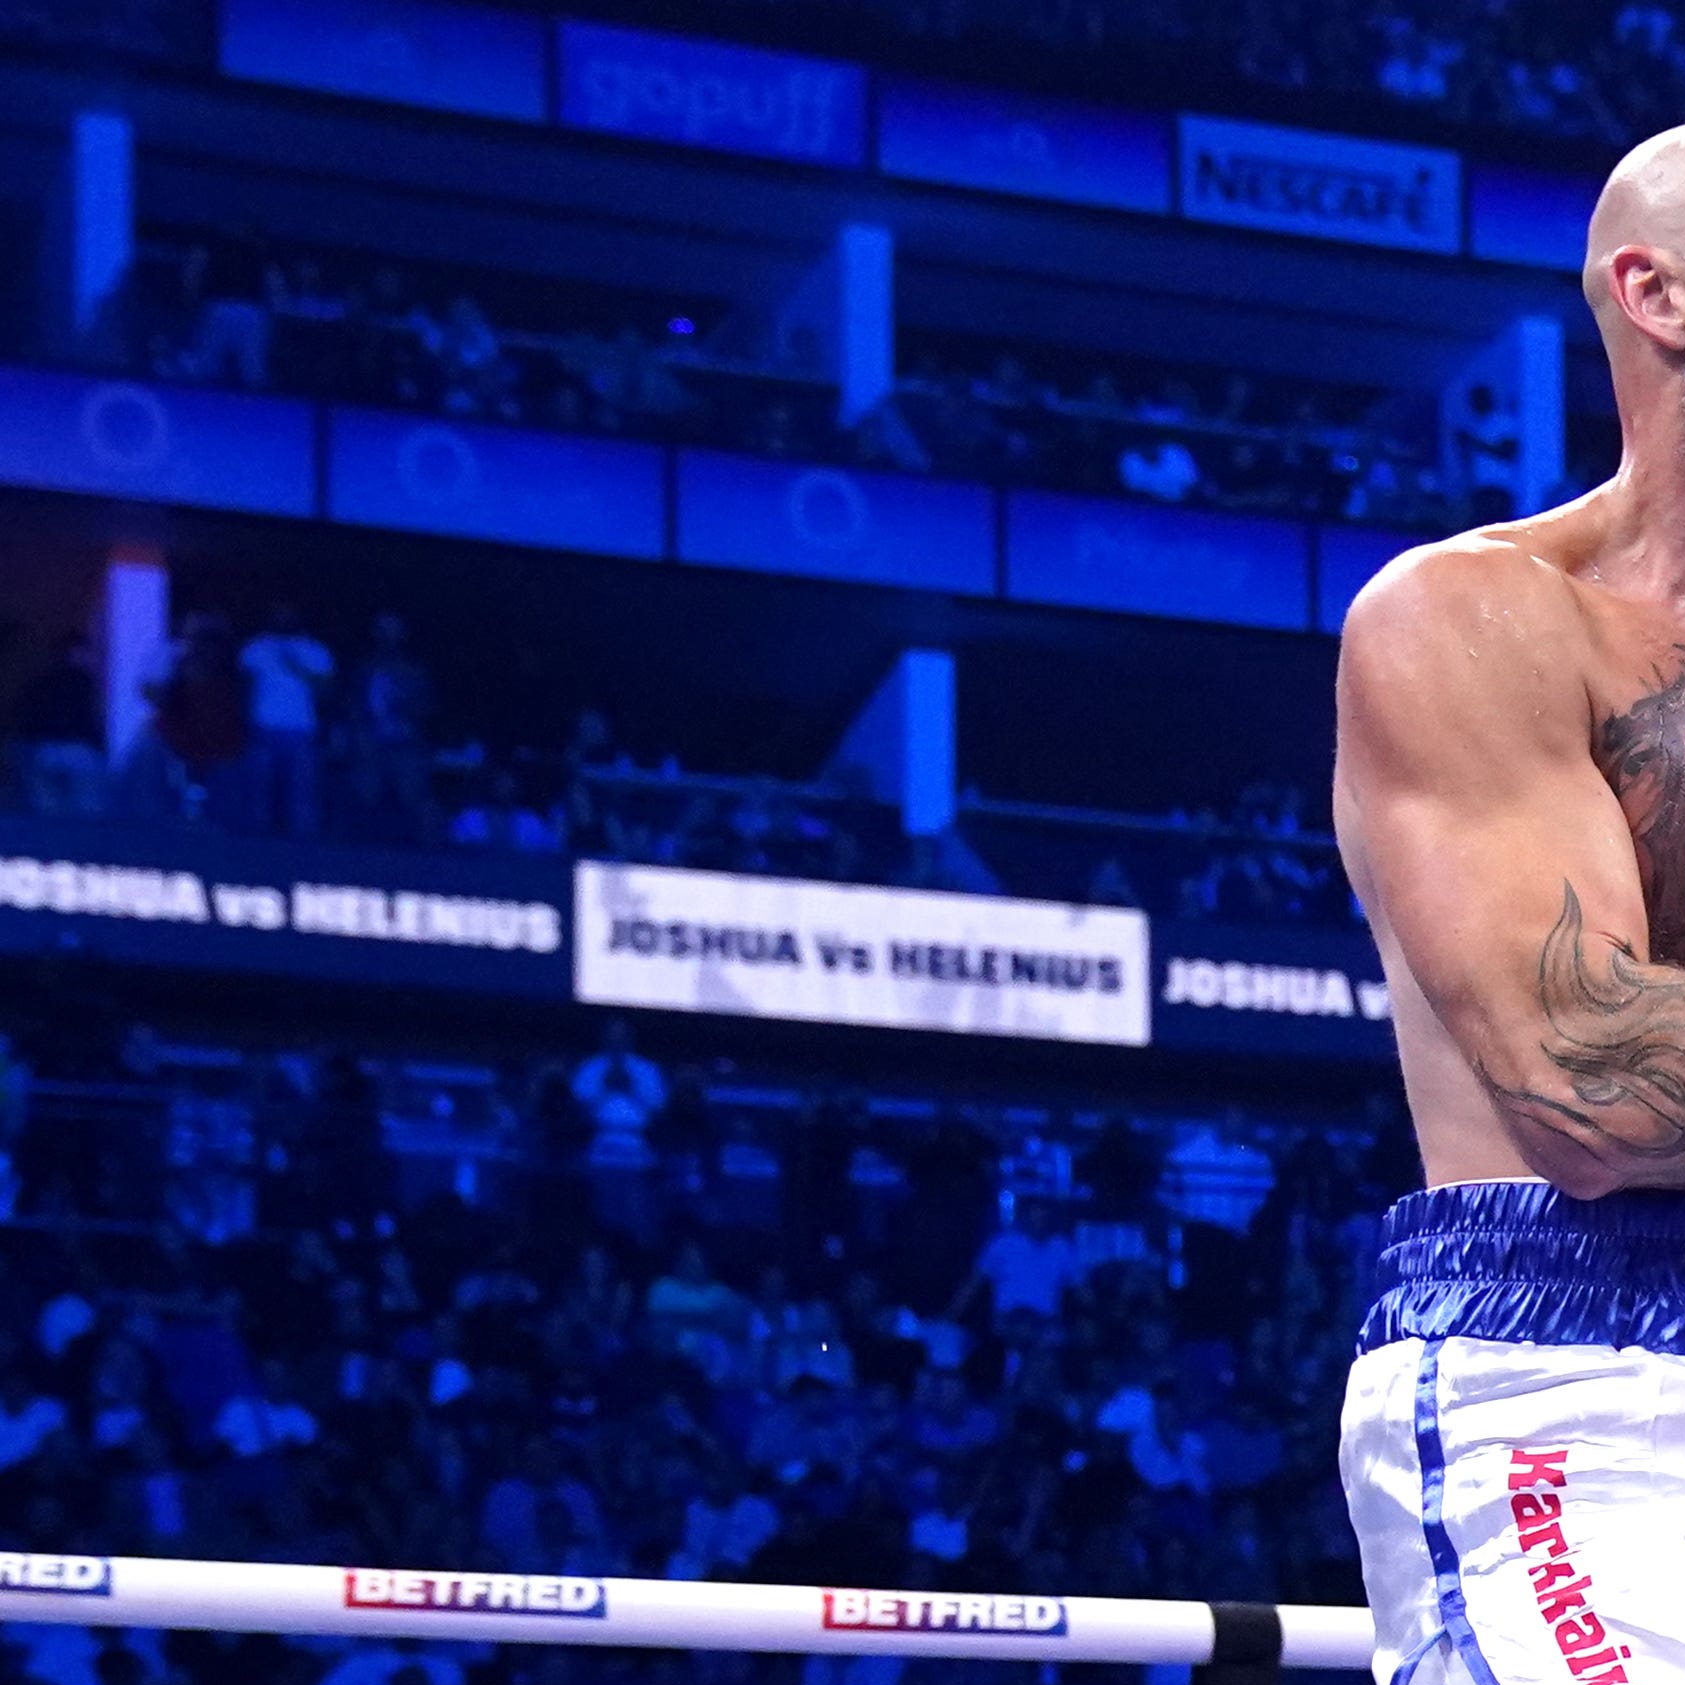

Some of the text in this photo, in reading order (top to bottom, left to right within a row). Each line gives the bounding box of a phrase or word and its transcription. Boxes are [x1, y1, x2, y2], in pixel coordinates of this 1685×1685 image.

[293, 884, 559, 951] HELENIUS
[610, 919, 801, 967] JOSHUA
[888, 940, 1122, 993] HELENIUS
[1165, 958, 1354, 1017] JOSHUA
[352, 1568, 602, 1614] BETFRED
[828, 1588, 1064, 1632] BETFRED
